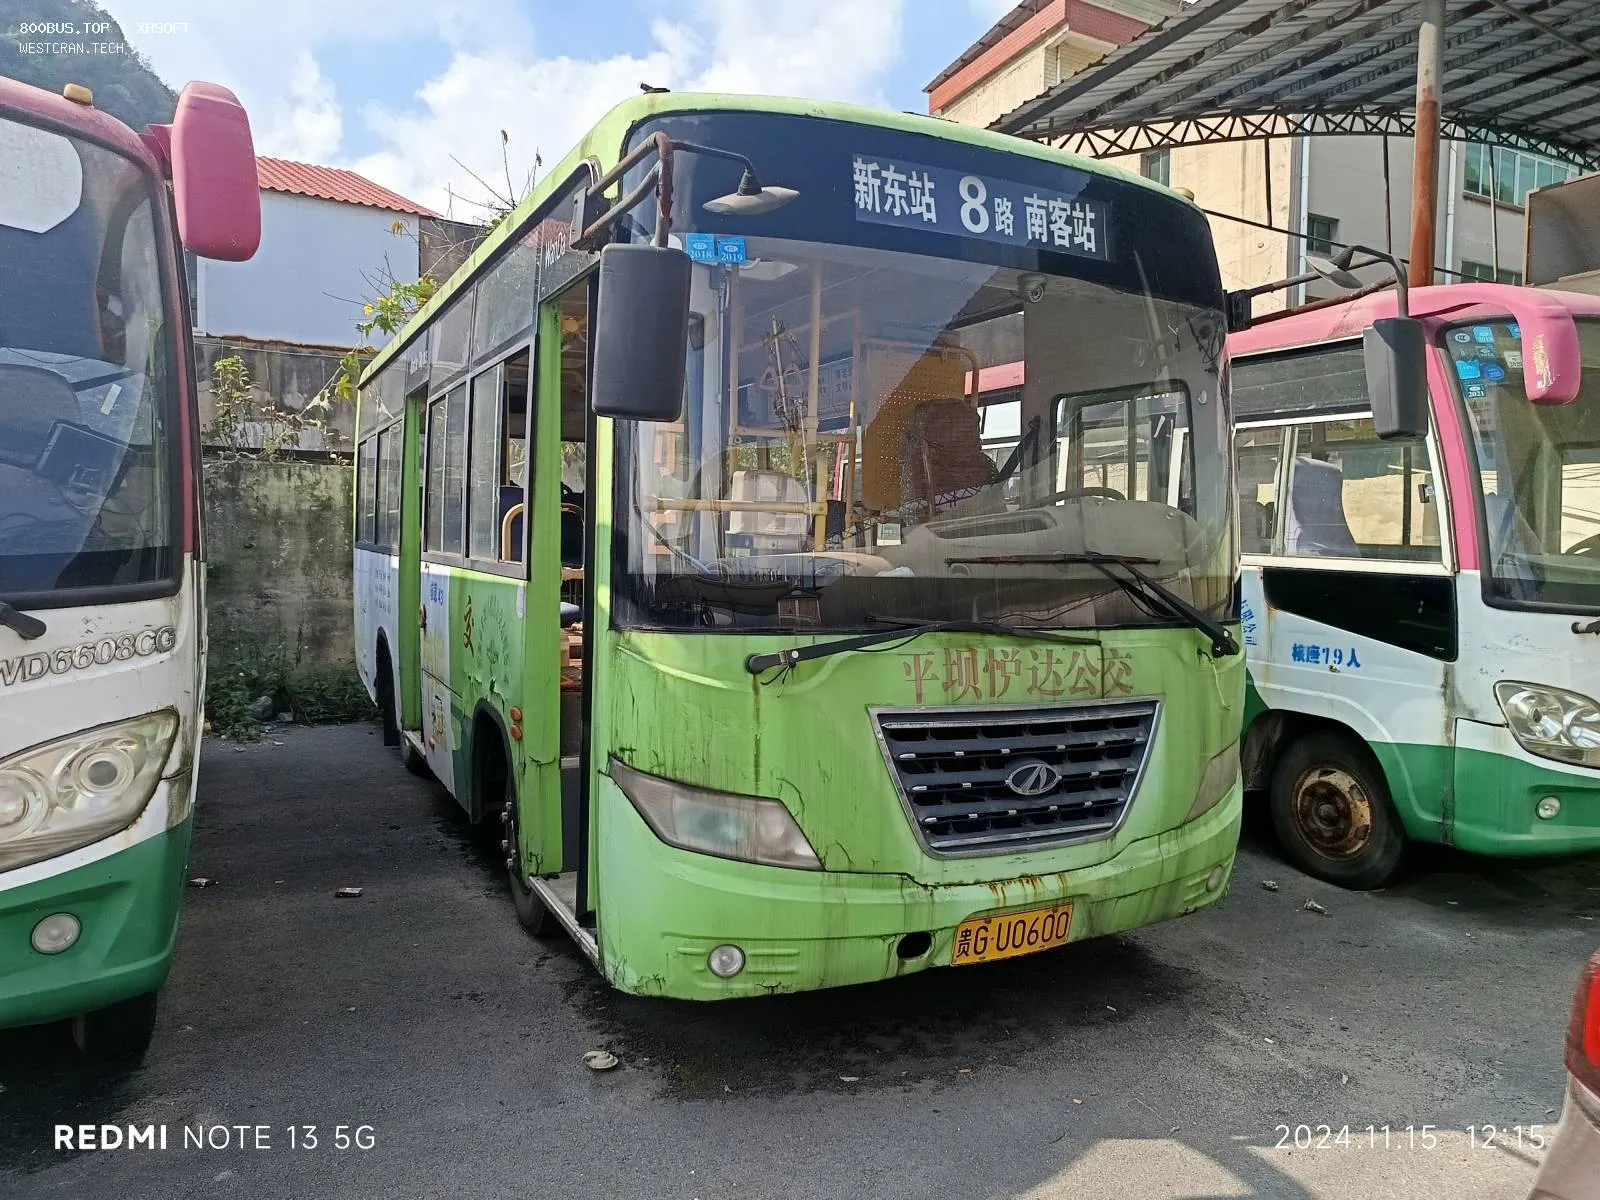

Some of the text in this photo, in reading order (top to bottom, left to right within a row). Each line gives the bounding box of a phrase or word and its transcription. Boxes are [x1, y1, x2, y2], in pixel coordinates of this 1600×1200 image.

[852, 157, 938, 224] 新东站
[1023, 193, 1097, 253] 南客站
[689, 250, 713, 259] 2018
[720, 251, 743, 261] 2019
[896, 646, 1134, 705] 平坝悦达公交
